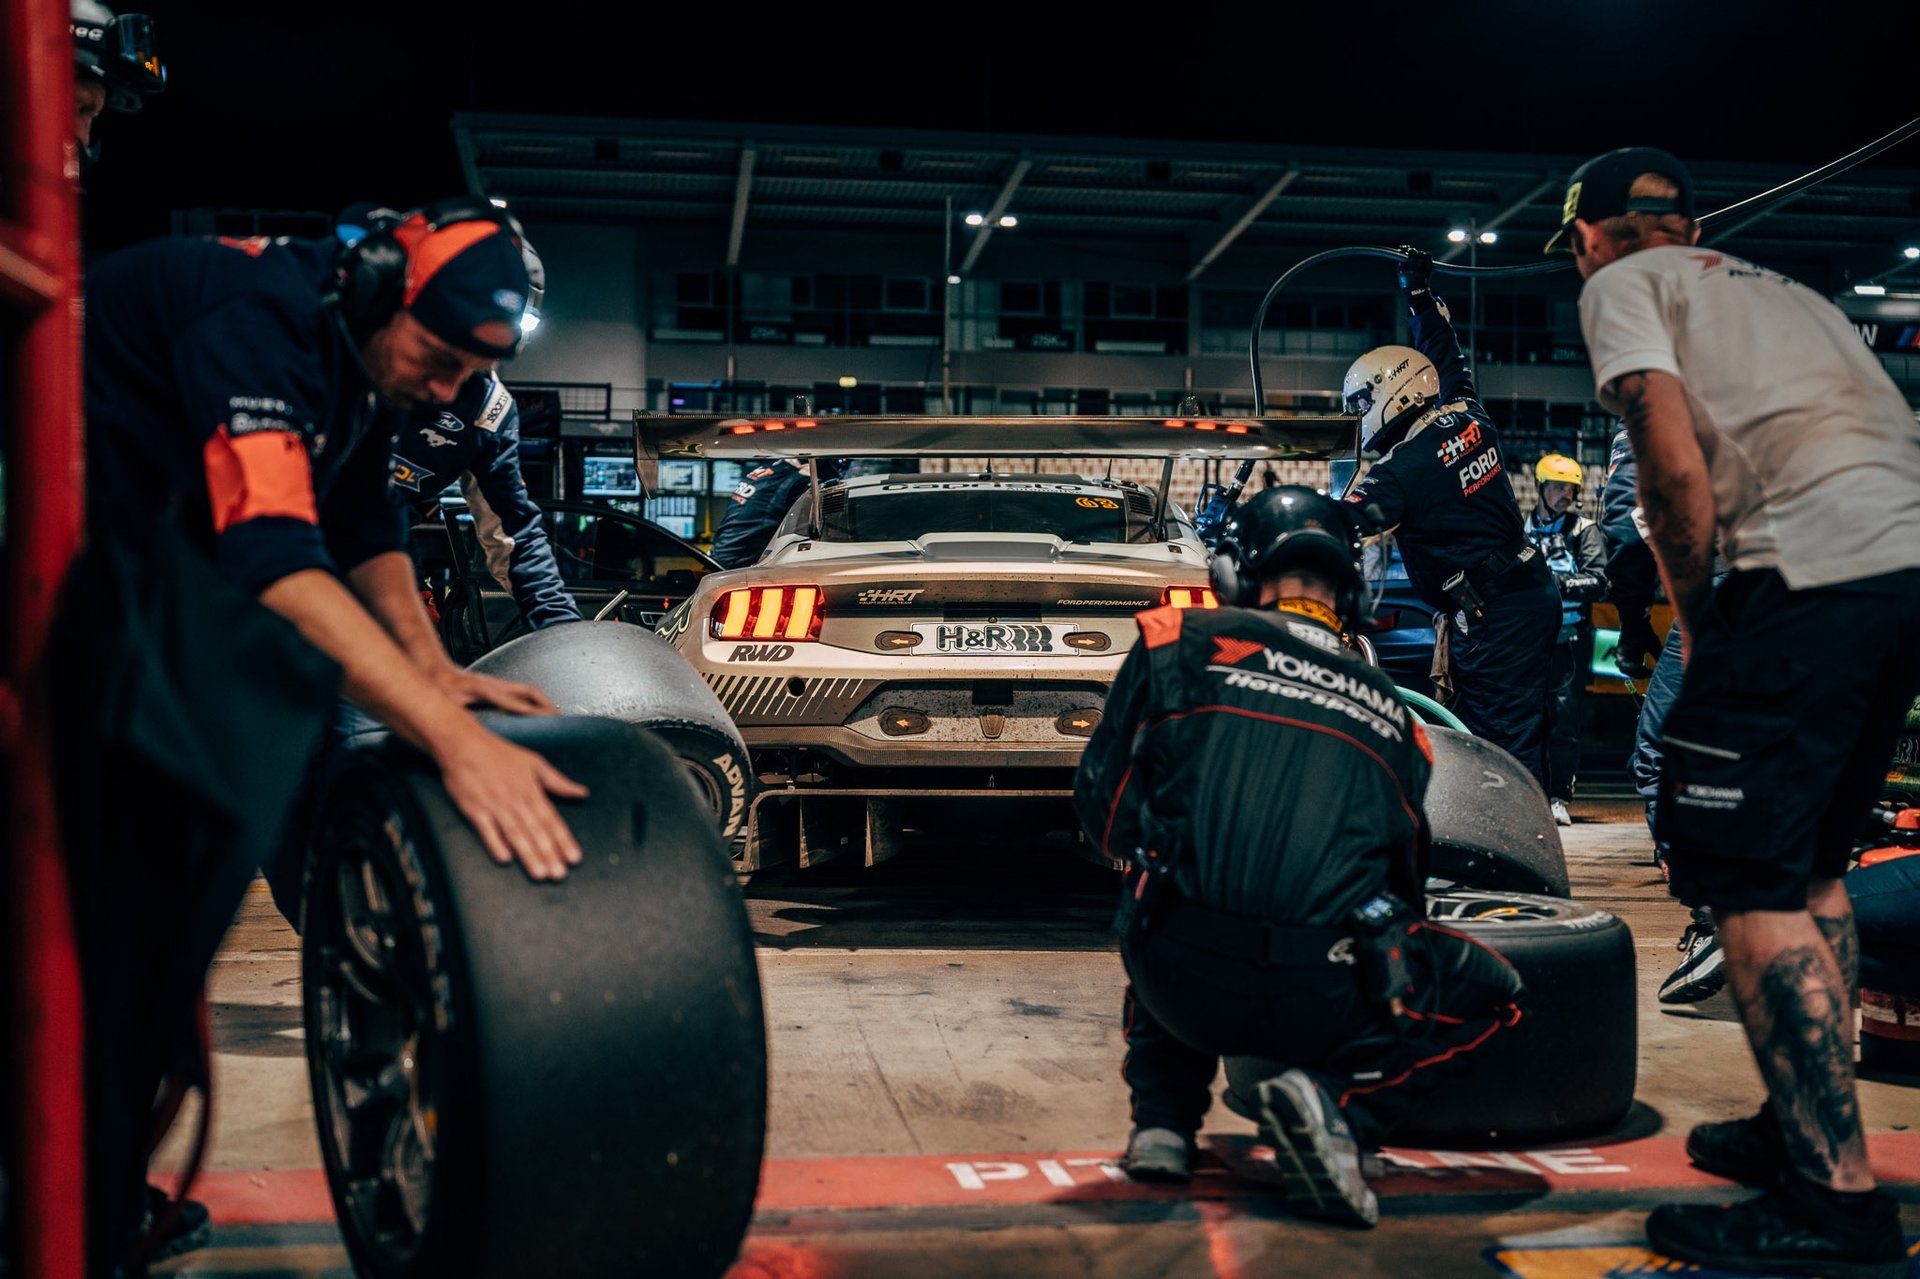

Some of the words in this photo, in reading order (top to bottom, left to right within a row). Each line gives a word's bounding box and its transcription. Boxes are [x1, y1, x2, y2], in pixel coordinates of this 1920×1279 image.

[1459, 446, 1498, 489] FORD
[863, 589, 925, 602] HRT
[728, 644, 795, 662] RWD
[937, 625, 1014, 652] H&R
[1263, 646, 1405, 731] YOKOHAMA
[712, 752, 745, 837] ADVAN
[946, 1158, 1134, 1191] PIT
